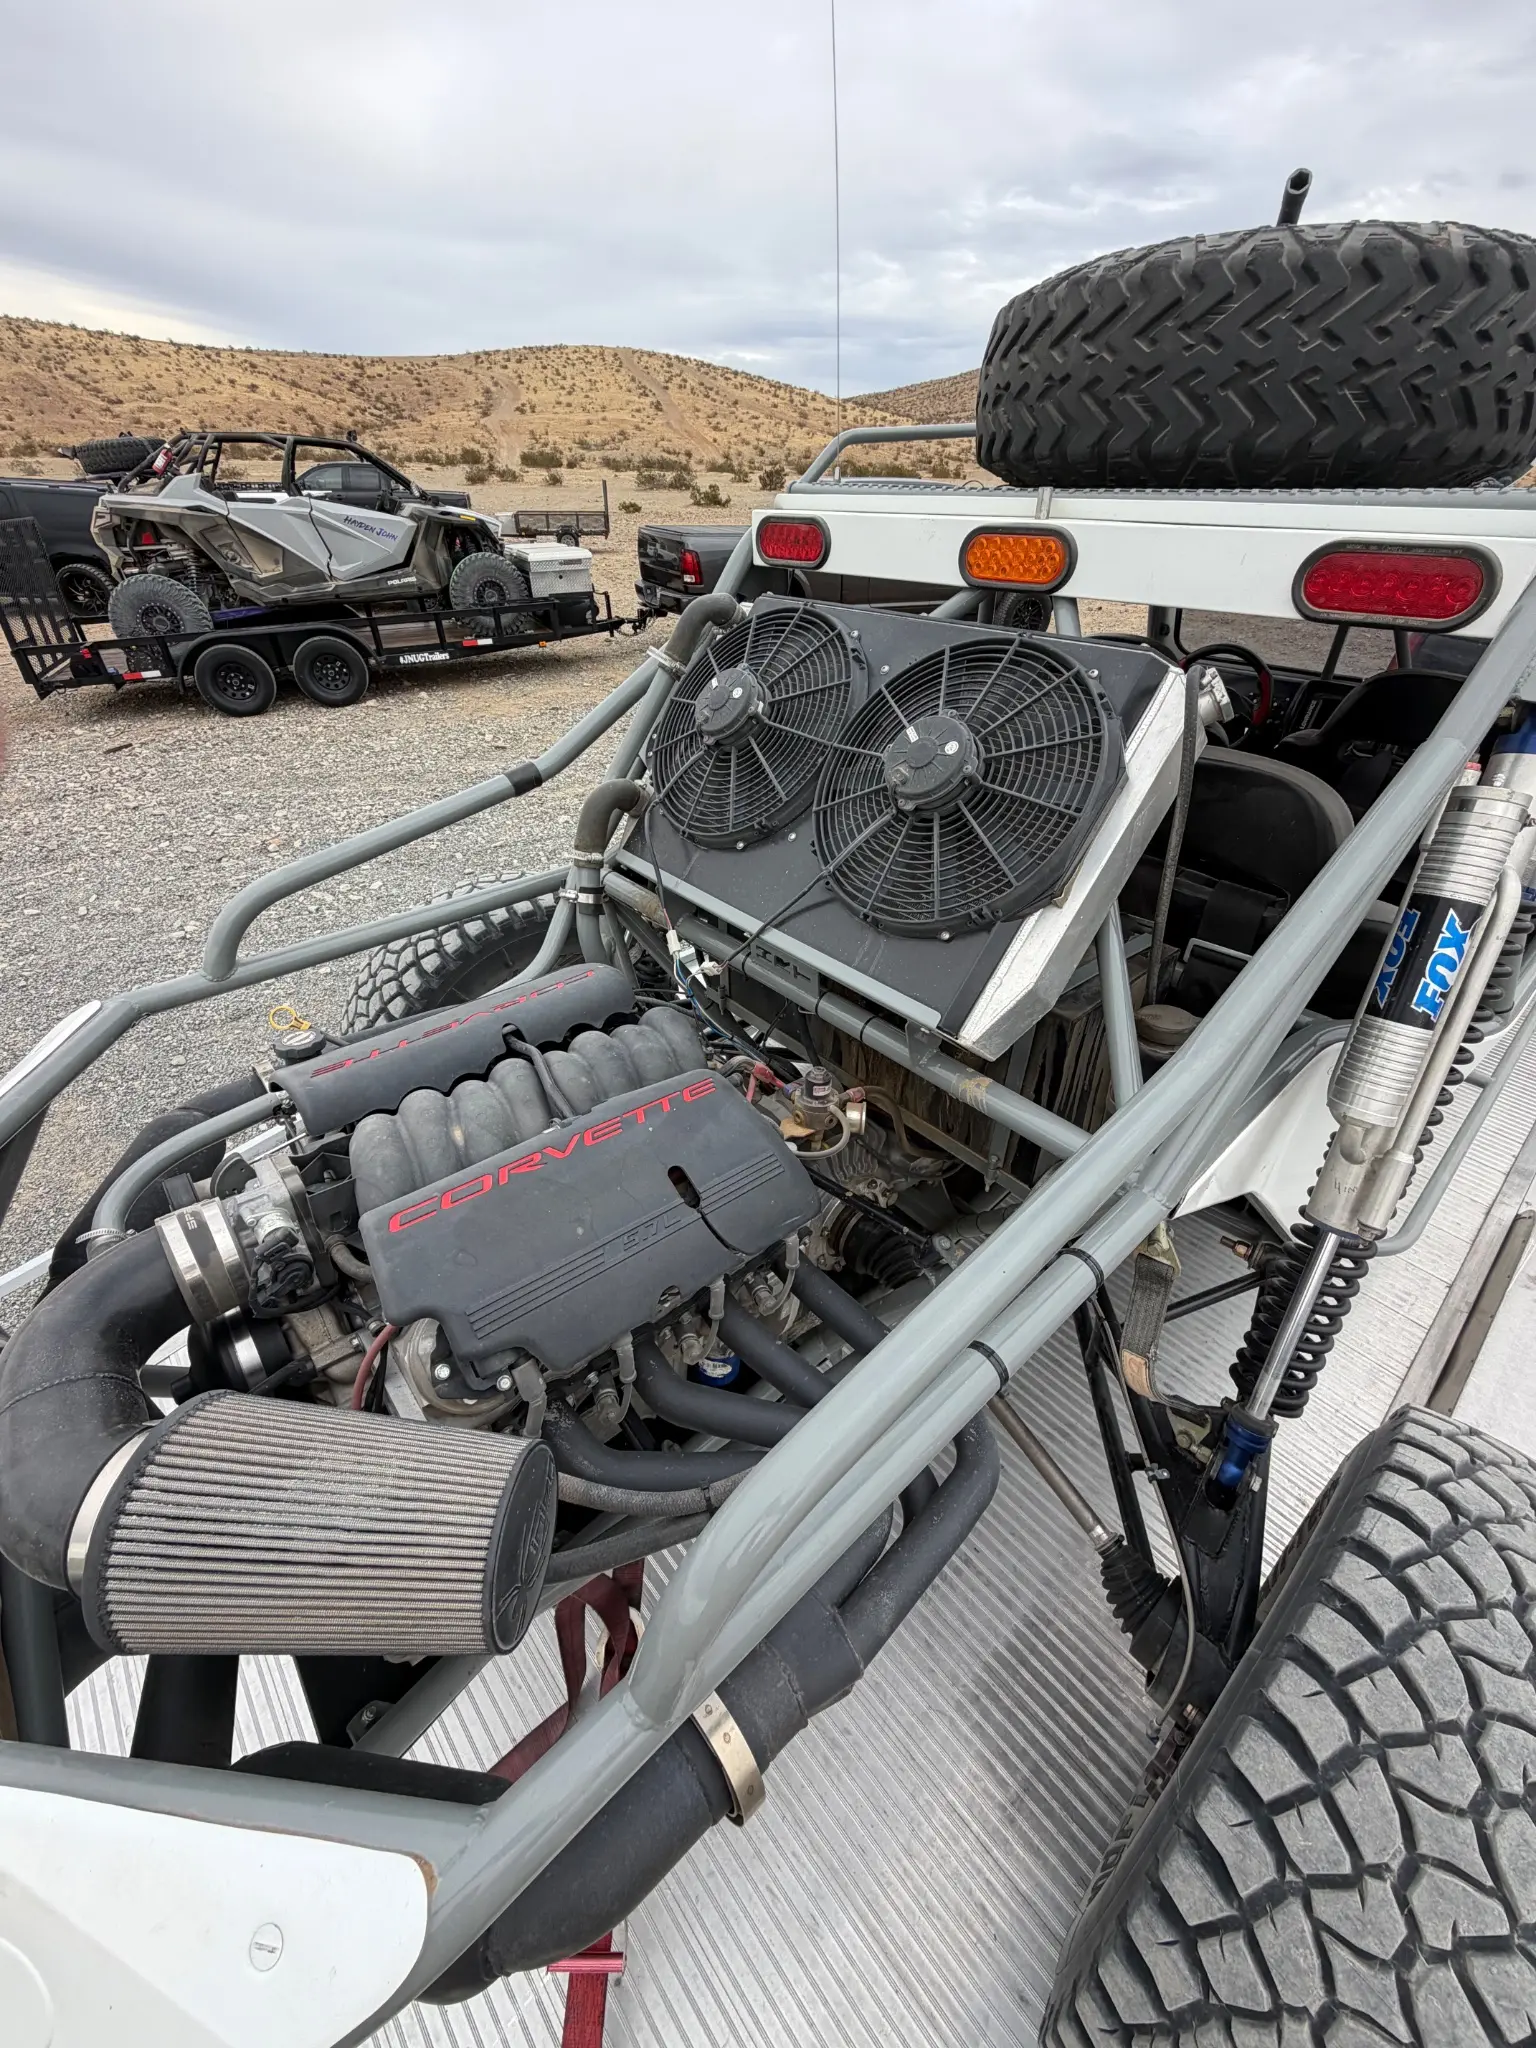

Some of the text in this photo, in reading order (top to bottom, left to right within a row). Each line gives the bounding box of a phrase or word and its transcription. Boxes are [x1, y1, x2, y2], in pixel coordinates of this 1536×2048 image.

[343, 515, 398, 541] HAYDEN JOHN
[387, 577, 417, 586] POLARIS
[1410, 907, 1471, 1022] FOX
[310, 970, 595, 1078] CORVETTE
[387, 1077, 717, 1234] CORVETTE
[623, 1215, 682, 1251] 5.7L
